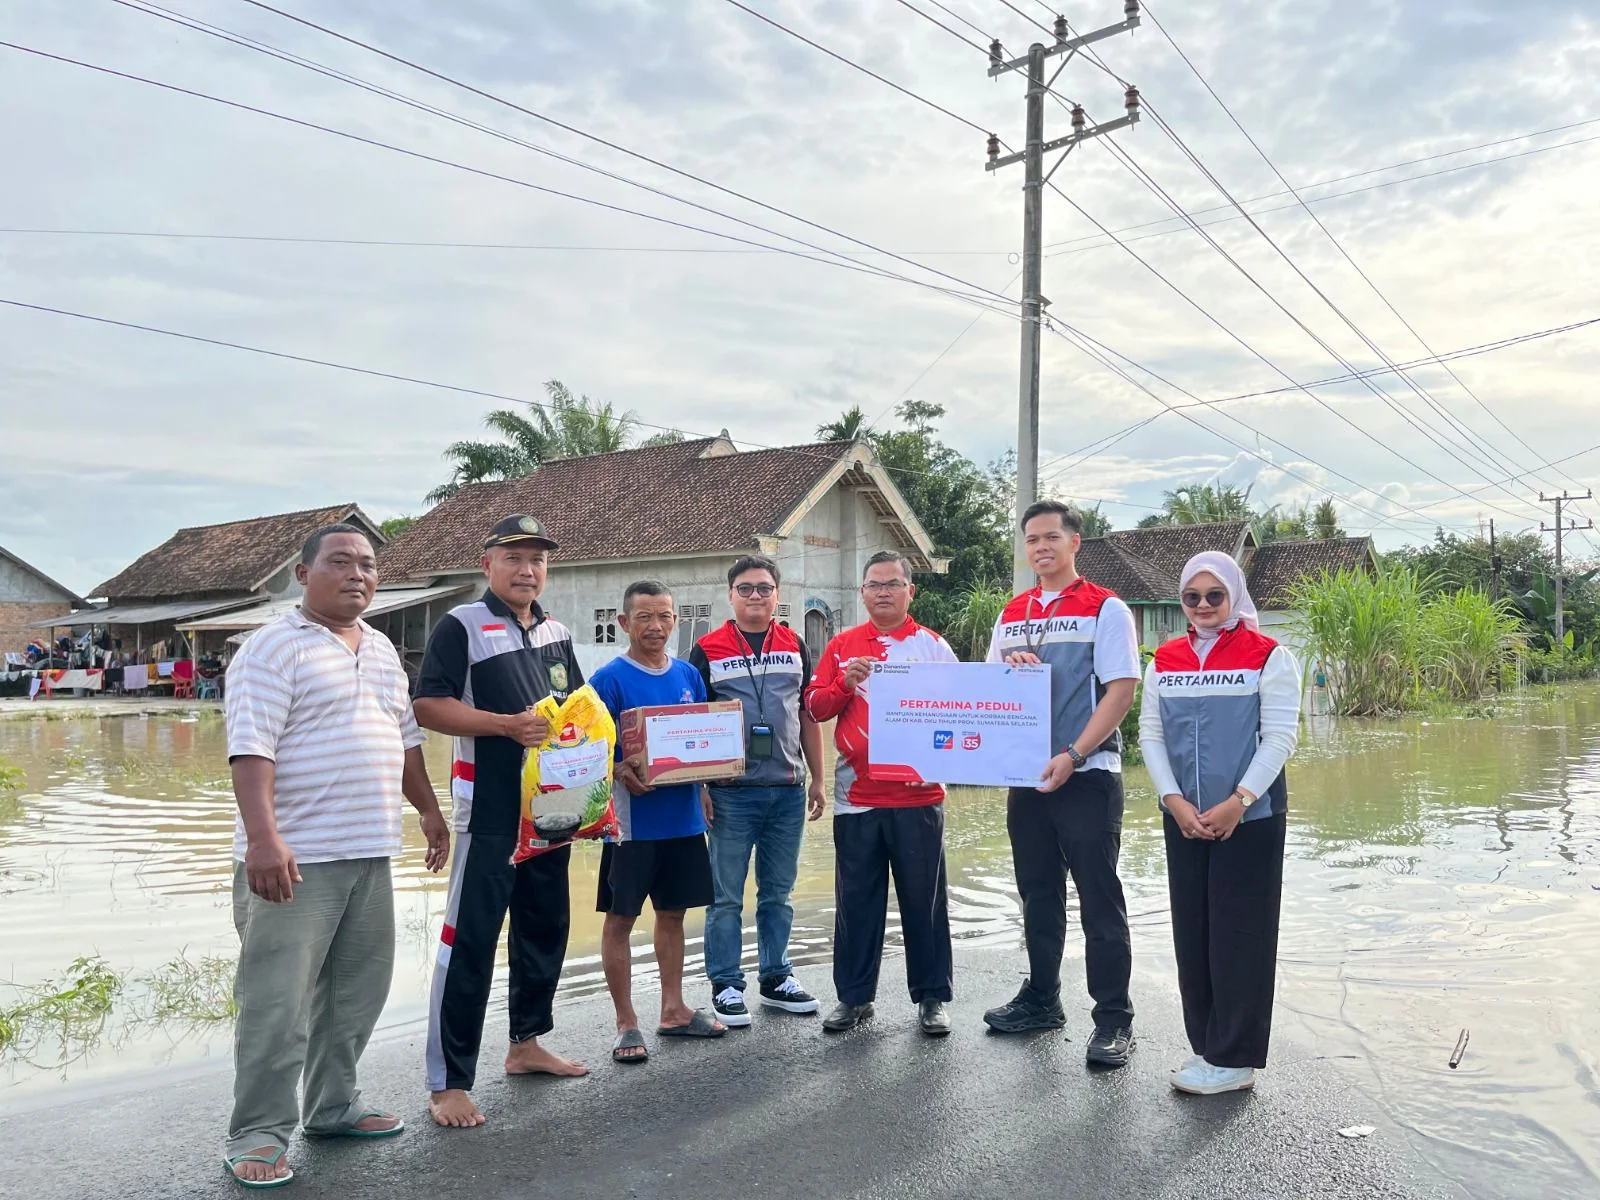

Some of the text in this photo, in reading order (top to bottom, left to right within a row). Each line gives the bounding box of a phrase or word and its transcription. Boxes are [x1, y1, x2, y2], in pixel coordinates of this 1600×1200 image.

[1005, 620, 1078, 638] PERTAMINA
[722, 655, 794, 671] PERTAMINA
[1158, 673, 1246, 687] PERTAMINA
[900, 699, 1022, 711] PERTAMINA PEDULI
[935, 733, 952, 744] My
